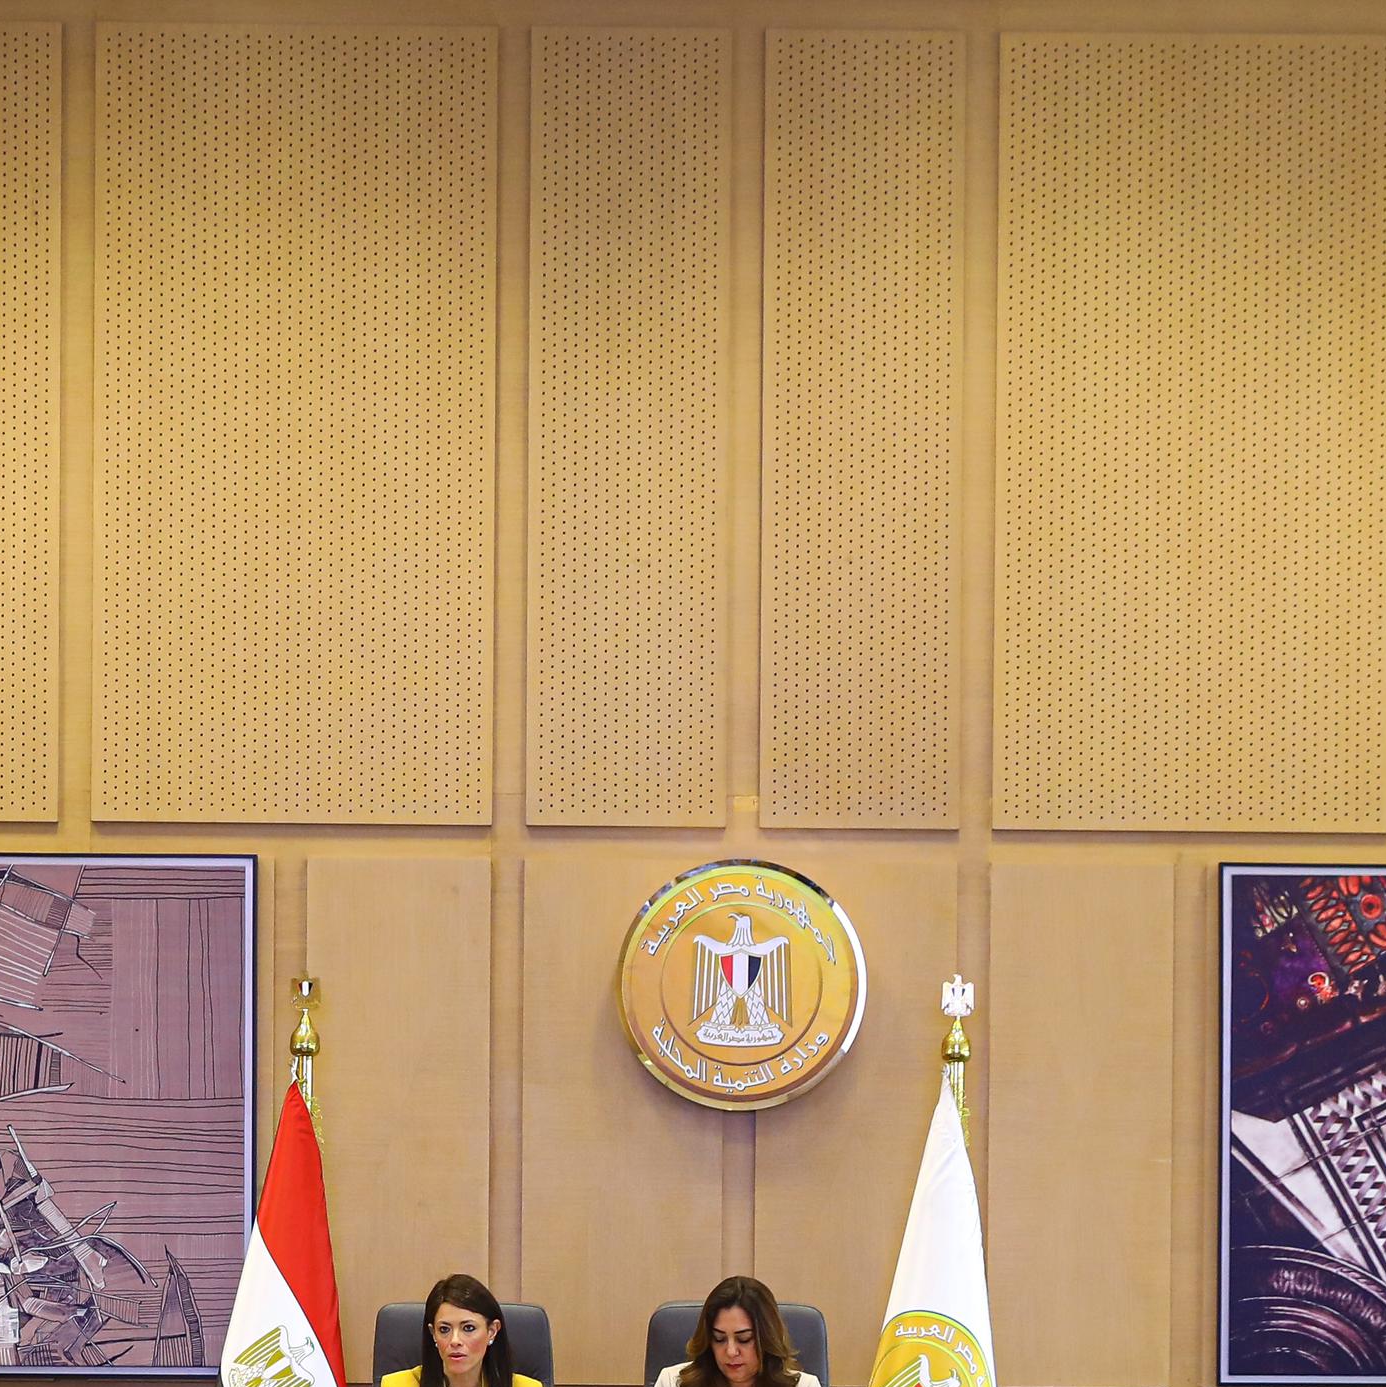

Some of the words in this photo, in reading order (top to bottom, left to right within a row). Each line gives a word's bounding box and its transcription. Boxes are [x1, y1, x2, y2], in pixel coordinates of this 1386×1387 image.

[709, 881, 750, 902] مصر
[640, 886, 705, 957] العربية
[755, 875, 837, 965] جمهورية
[651, 1017, 708, 1083] المحلية
[703, 1028, 729, 1041] العربية
[728, 1035, 745, 1043] مصر
[745, 1030, 777, 1043] جمهورية
[779, 1030, 830, 1076] وزارة
[713, 1063, 775, 1095] التنمية
[895, 1322, 956, 1344] العربية
[954, 1341, 978, 1374] مصر
